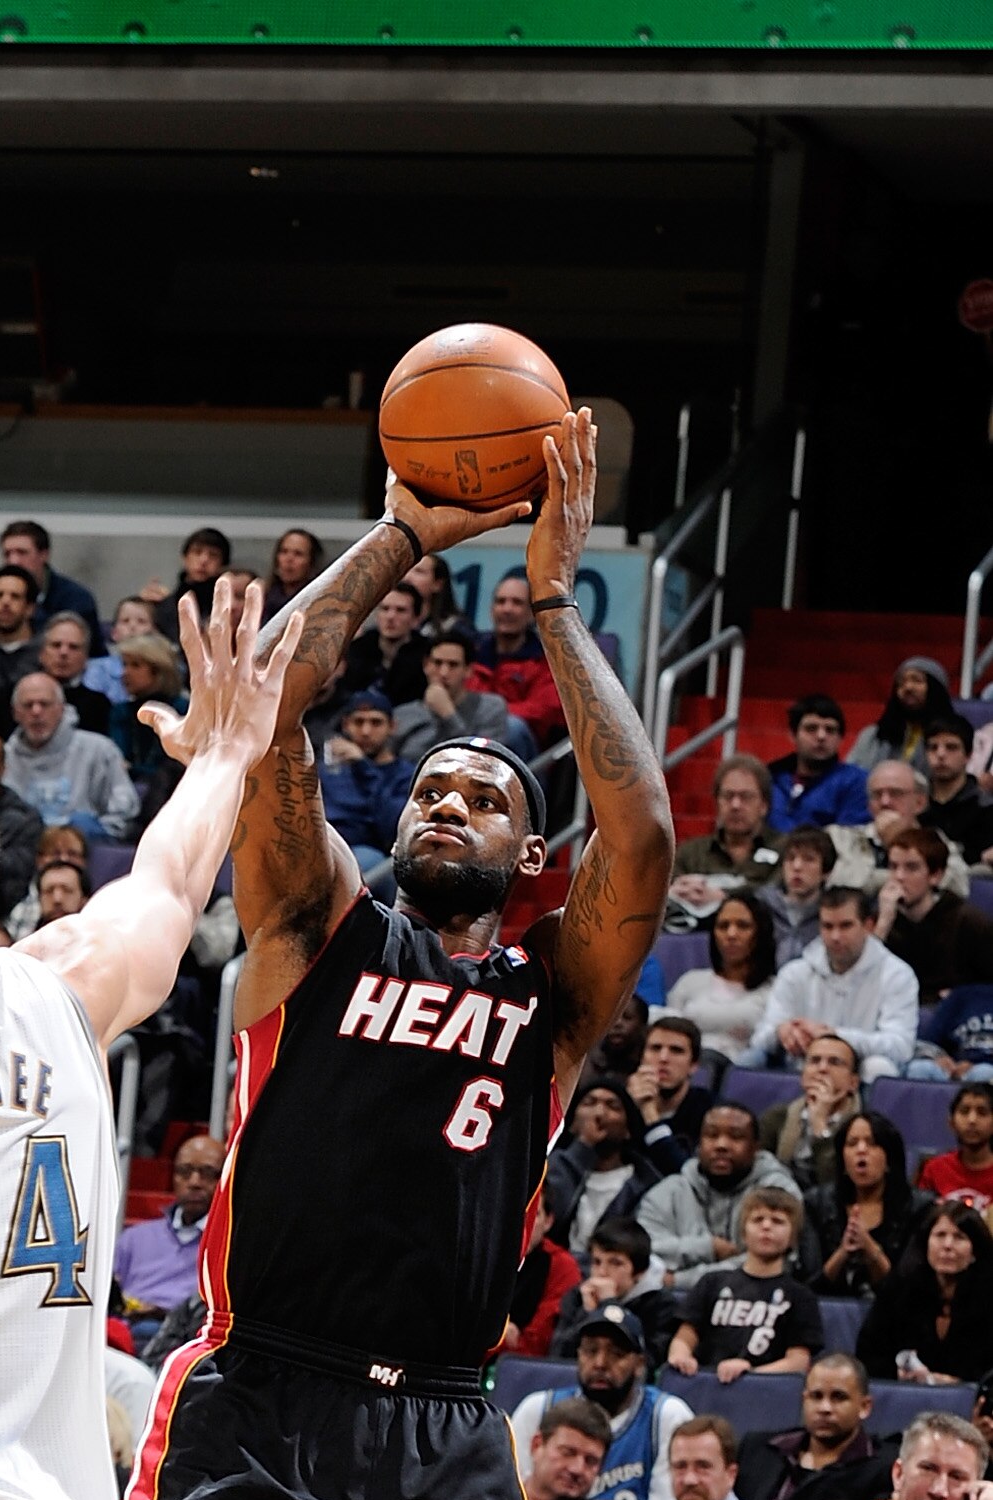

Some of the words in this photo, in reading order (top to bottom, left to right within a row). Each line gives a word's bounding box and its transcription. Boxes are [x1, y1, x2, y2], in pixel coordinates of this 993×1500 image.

[338, 971, 539, 1066] HEAT
[443, 1075, 505, 1153] 6
[710, 1299, 791, 1327] HEAT
[747, 1326, 775, 1356] 6
